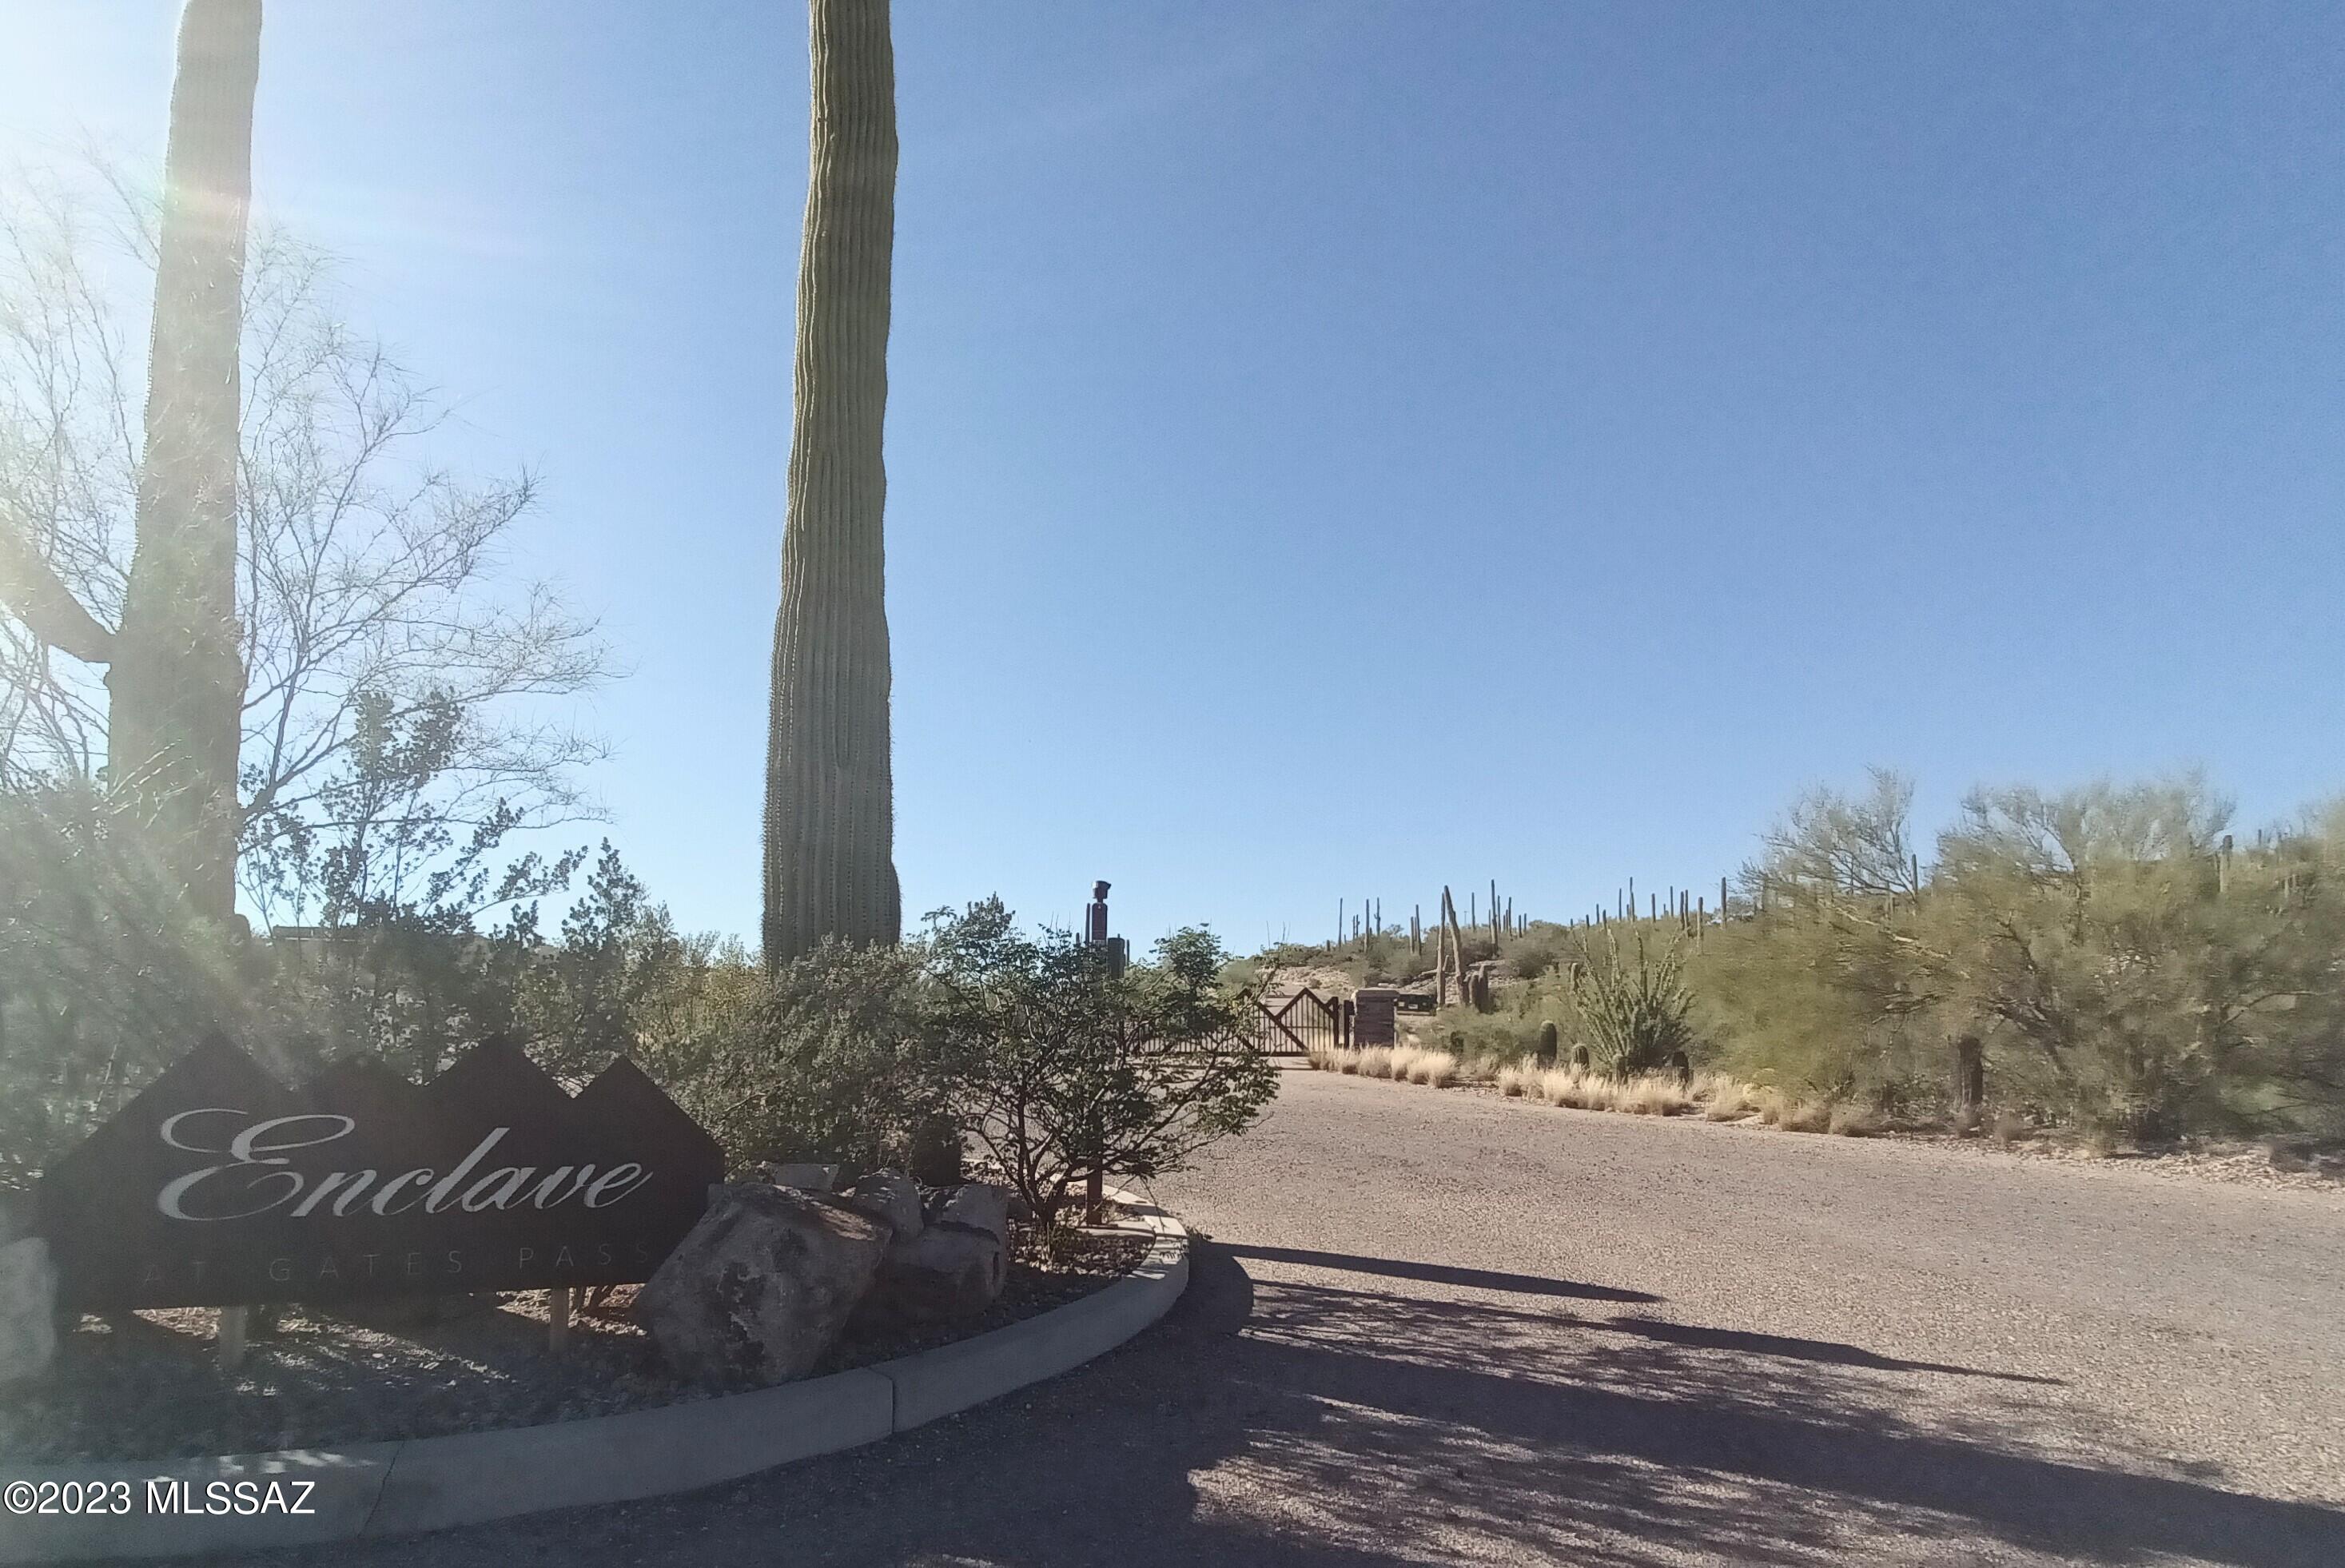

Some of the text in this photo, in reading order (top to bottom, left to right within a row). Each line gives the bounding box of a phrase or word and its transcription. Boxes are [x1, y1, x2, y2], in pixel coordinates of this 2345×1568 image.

[159, 1108, 654, 1221] Enclave
[268, 1249, 463, 1281] GATES
[518, 1240, 649, 1270] PASS
